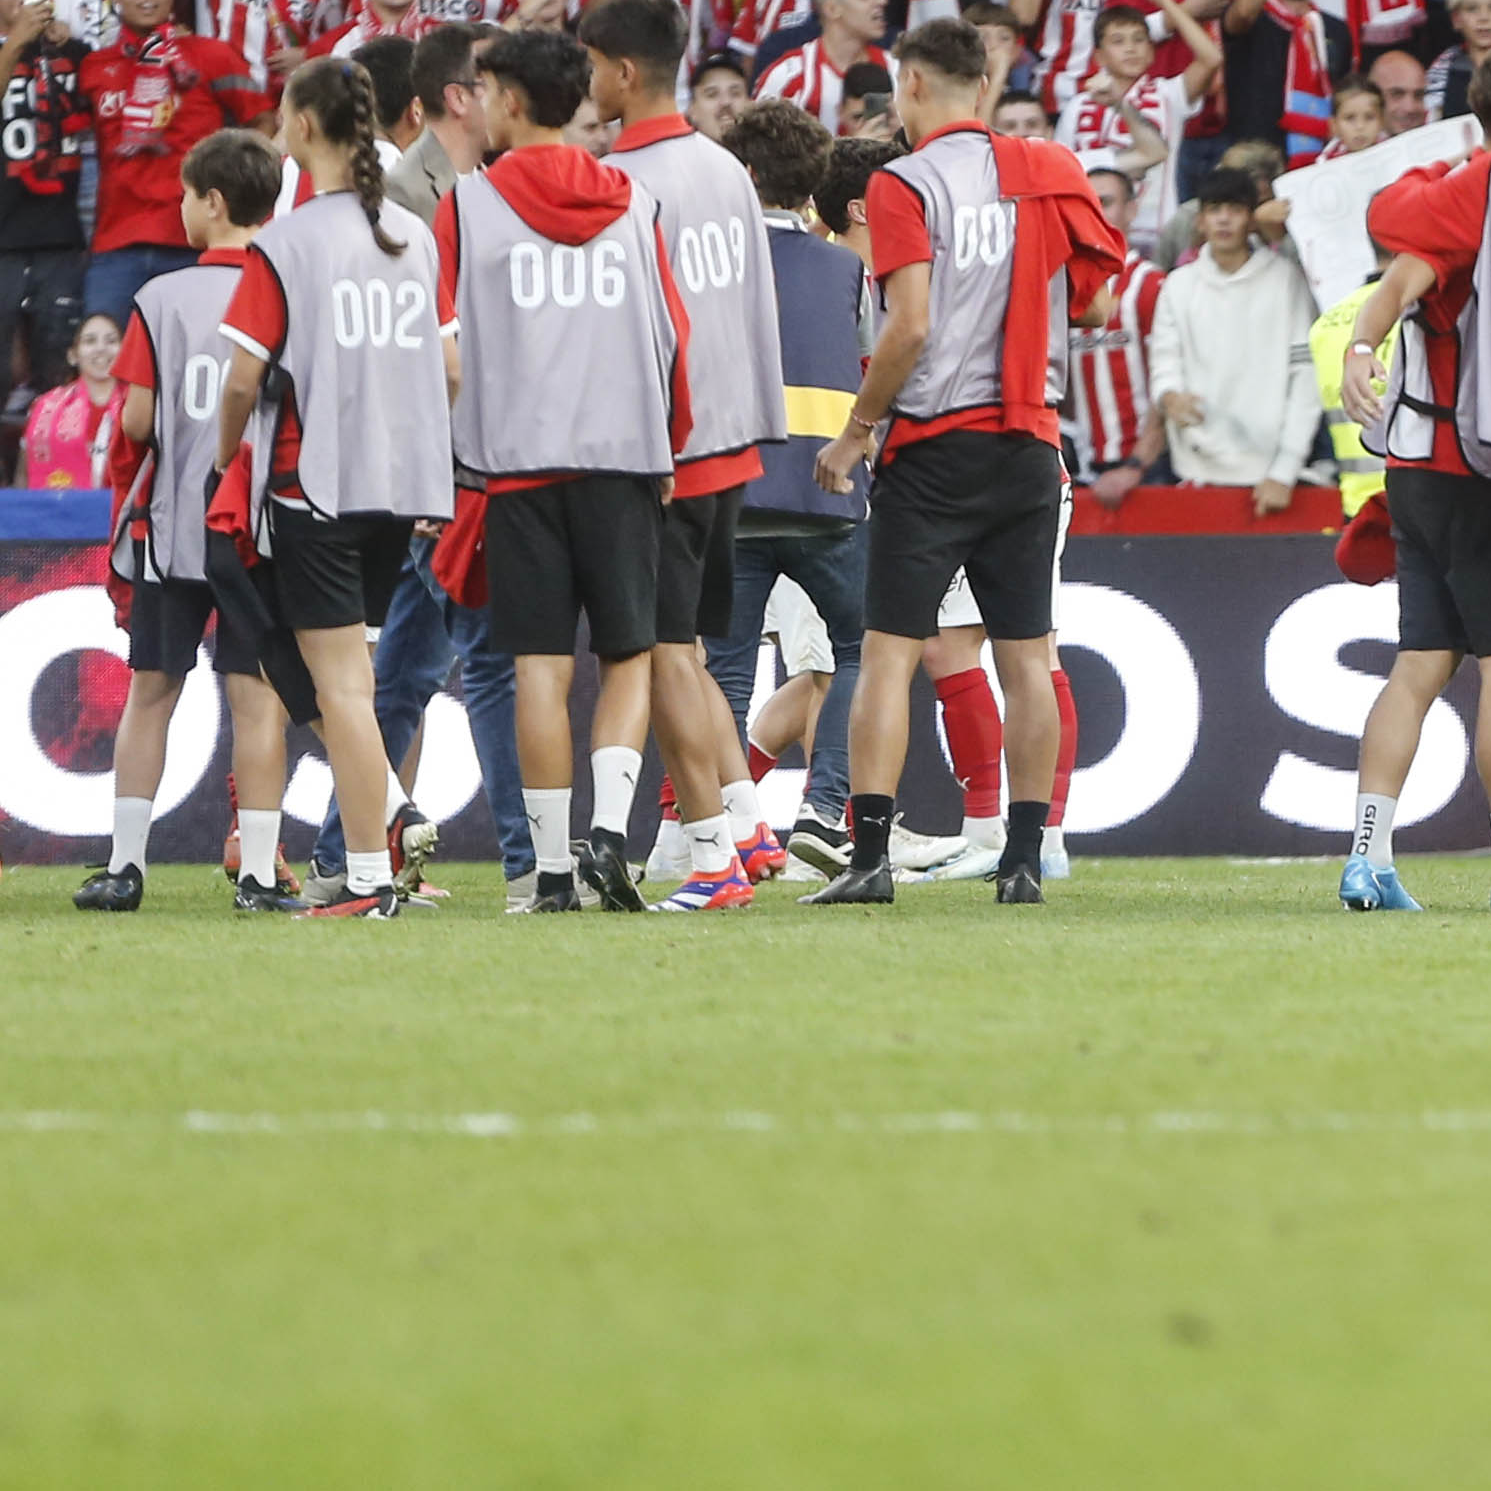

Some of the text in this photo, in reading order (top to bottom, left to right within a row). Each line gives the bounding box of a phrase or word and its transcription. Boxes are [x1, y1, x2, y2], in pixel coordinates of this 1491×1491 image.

[508, 238, 625, 309] 006
[678, 215, 745, 293] 009
[332, 277, 426, 349] 002
